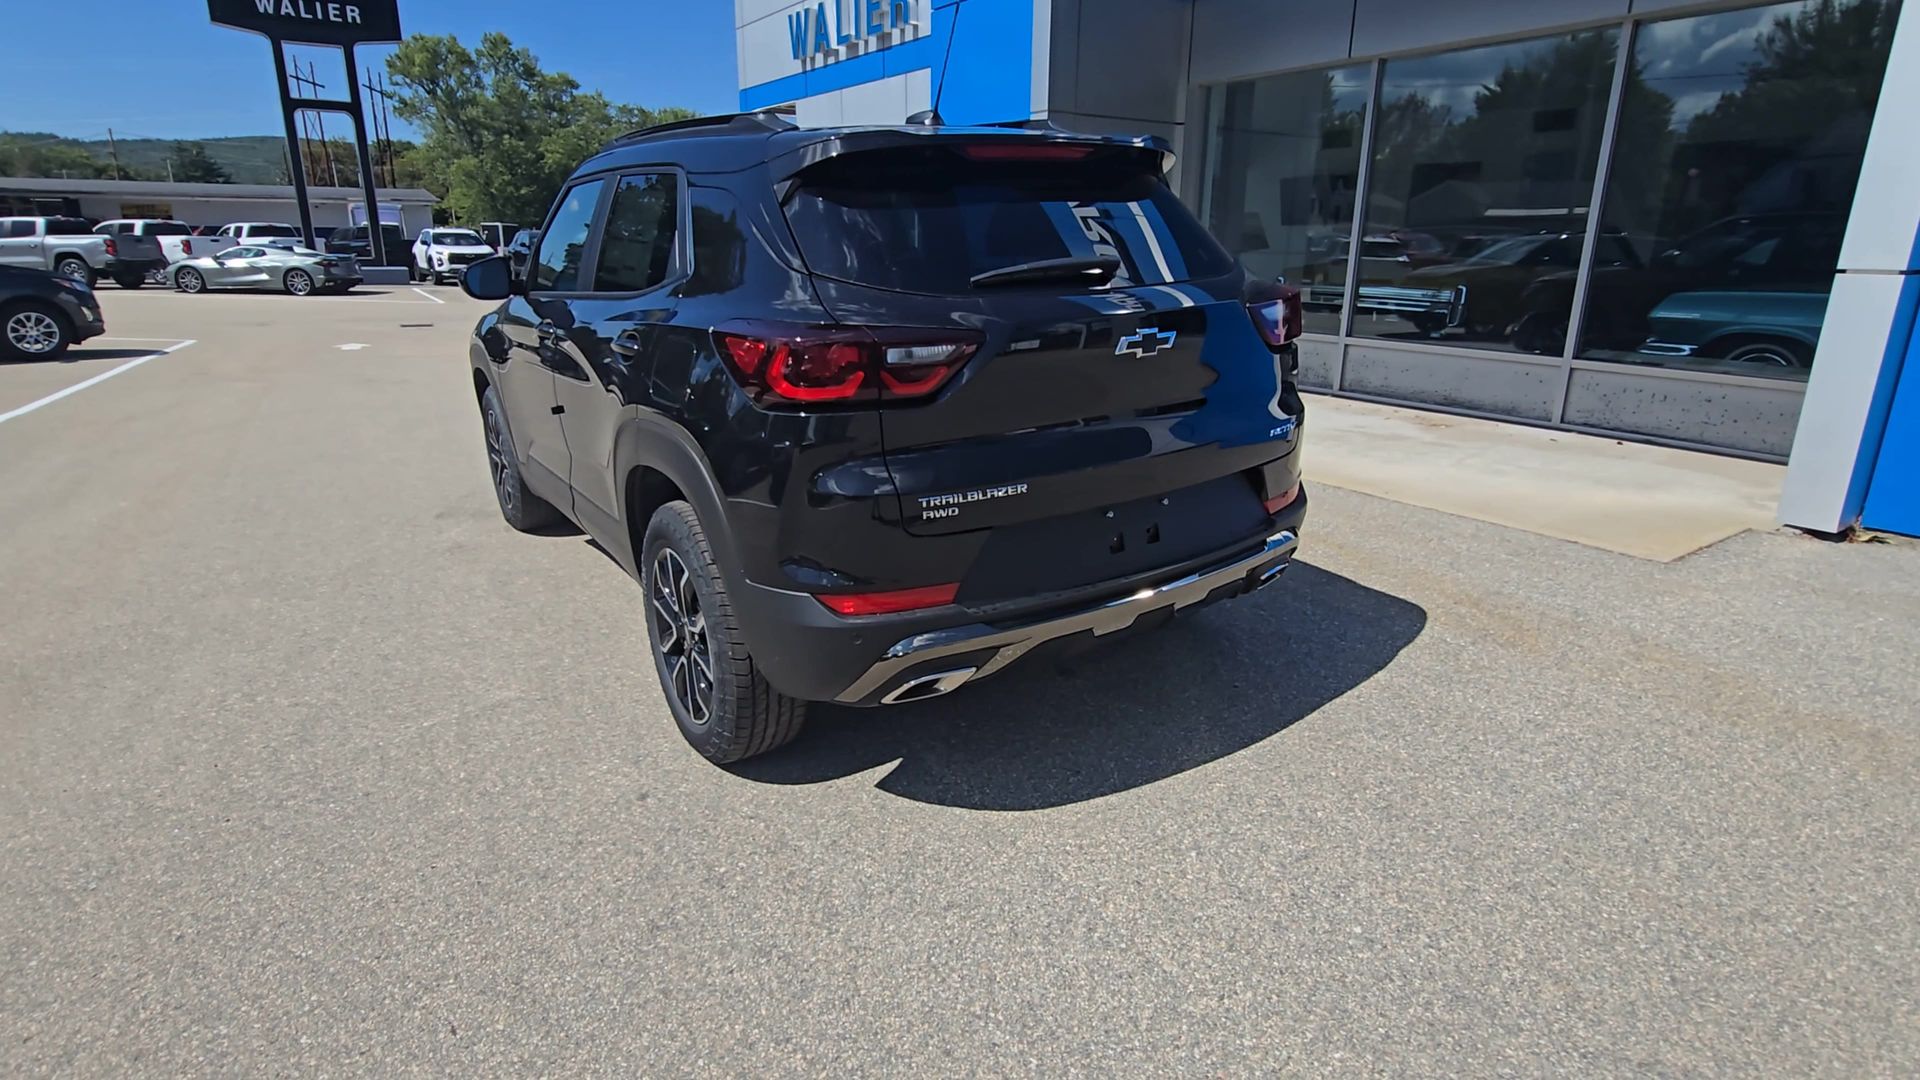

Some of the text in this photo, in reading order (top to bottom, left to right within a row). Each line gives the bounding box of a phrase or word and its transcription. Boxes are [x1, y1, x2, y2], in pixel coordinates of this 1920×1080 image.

[254, 0, 361, 24] WALIER
[918, 483, 1028, 508] TRAILBLAZER
[922, 507, 959, 520] AWD
